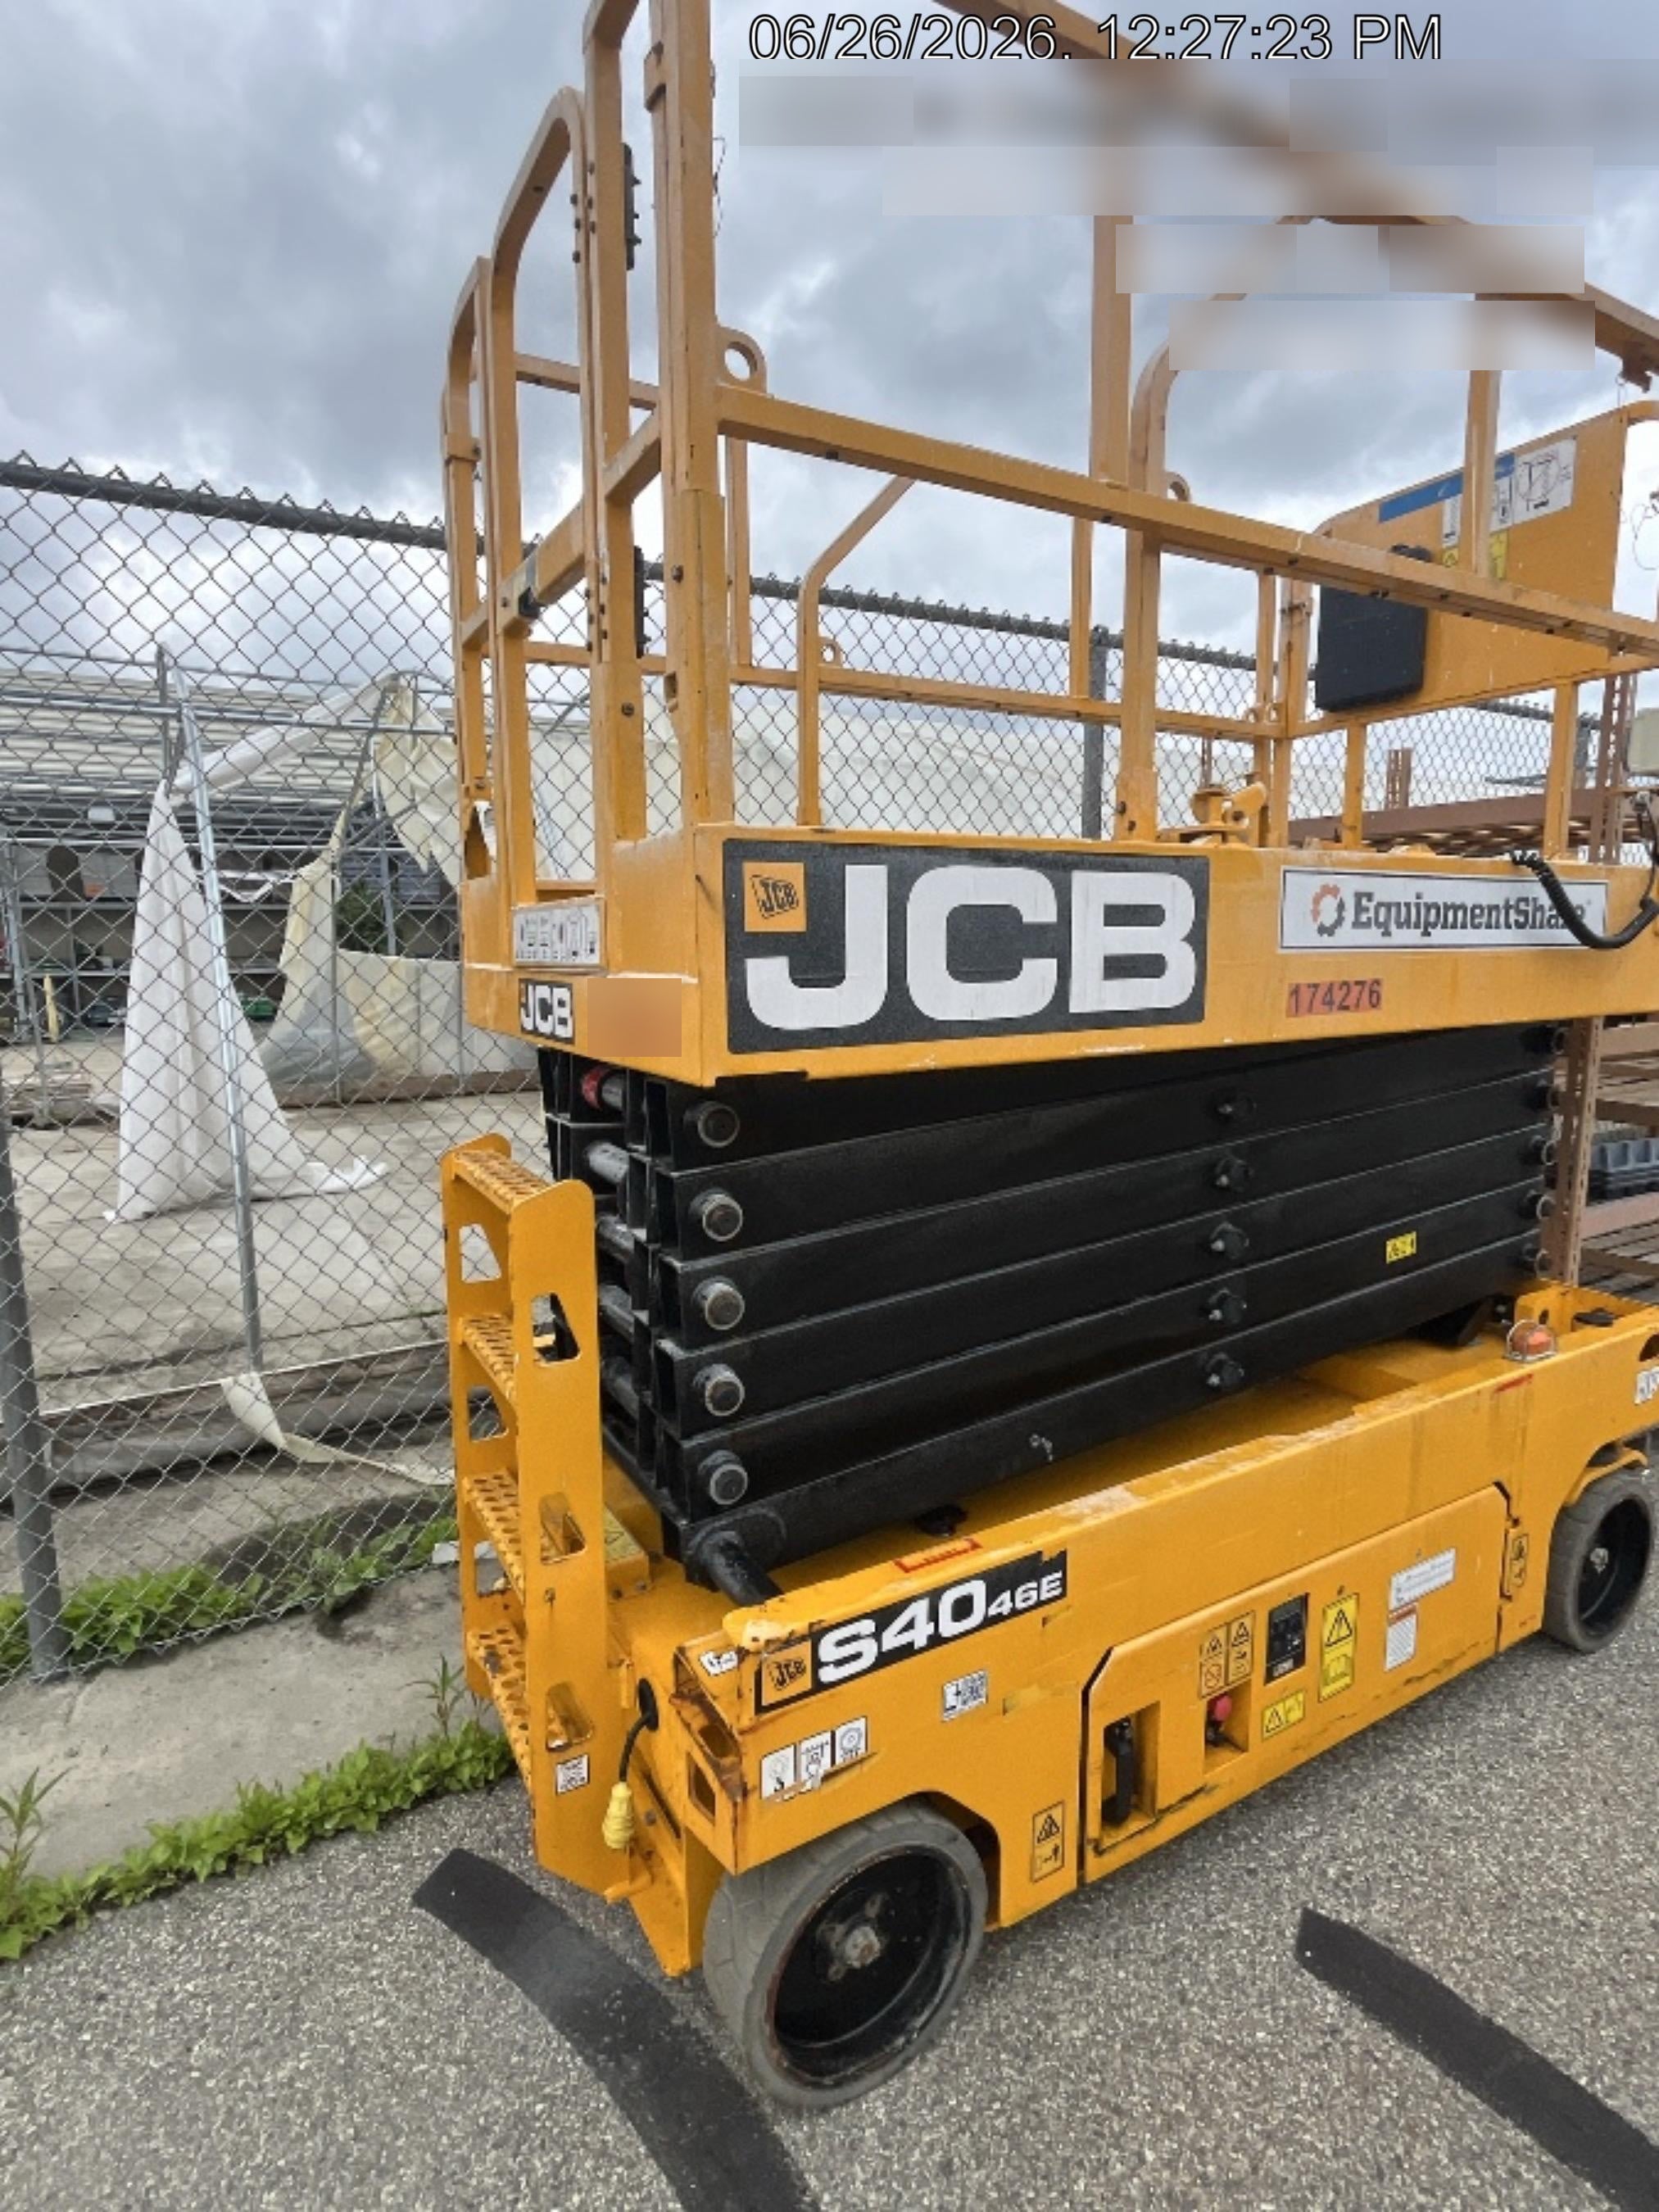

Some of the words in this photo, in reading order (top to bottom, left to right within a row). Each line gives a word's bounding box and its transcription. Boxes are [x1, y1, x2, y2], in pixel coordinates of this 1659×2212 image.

[757, 876, 798, 915] JCB
[746, 864, 1196, 1030] JCB
[520, 983, 573, 1038] JCB
[1289, 980, 1383, 1015] 174276
